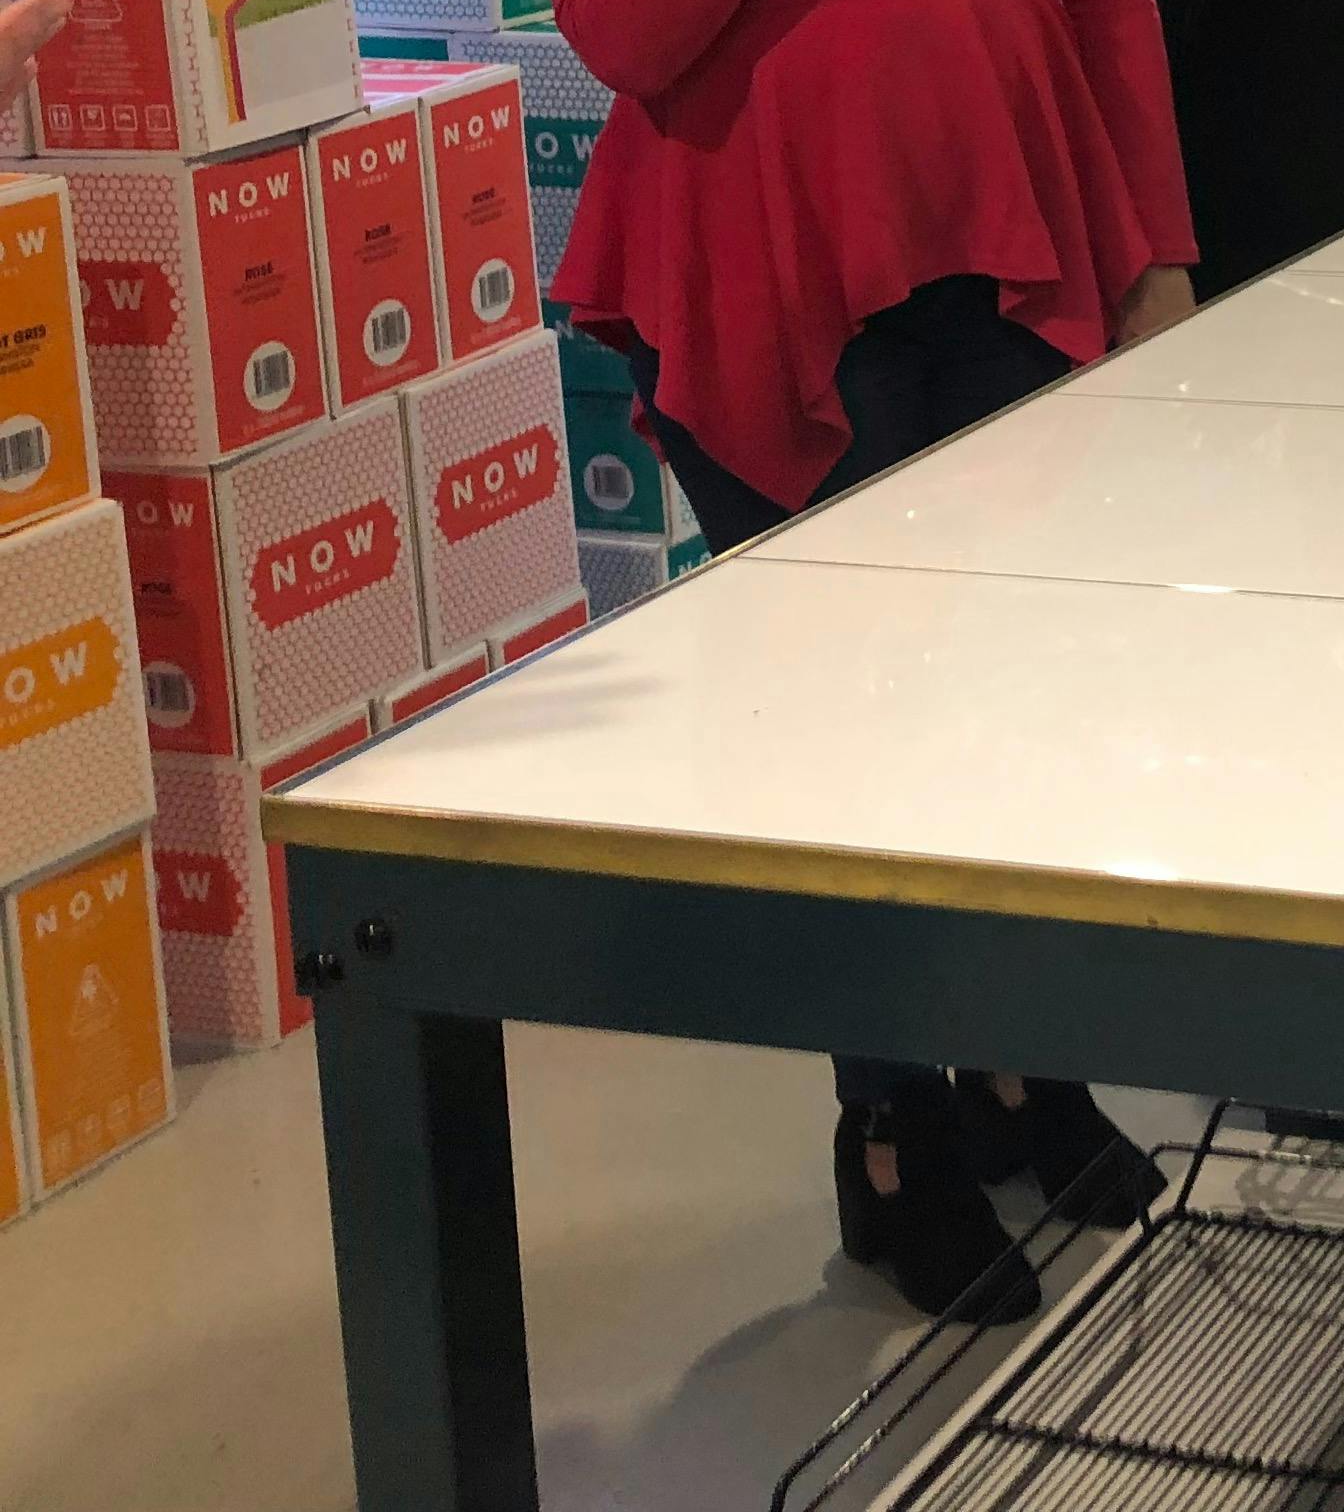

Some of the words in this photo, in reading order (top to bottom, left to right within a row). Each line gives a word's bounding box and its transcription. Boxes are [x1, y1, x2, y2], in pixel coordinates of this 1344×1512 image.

[443, 105, 510, 149] NOW
[535, 132, 598, 162] OW
[332, 138, 407, 182] NOW
[208, 172, 289, 217] NOW
[452, 443, 538, 509] NOW
[137, 500, 194, 527] OW
[271, 520, 374, 593] NOW
[4, 642, 87, 703] OW
[35, 868, 128, 938] NOW
